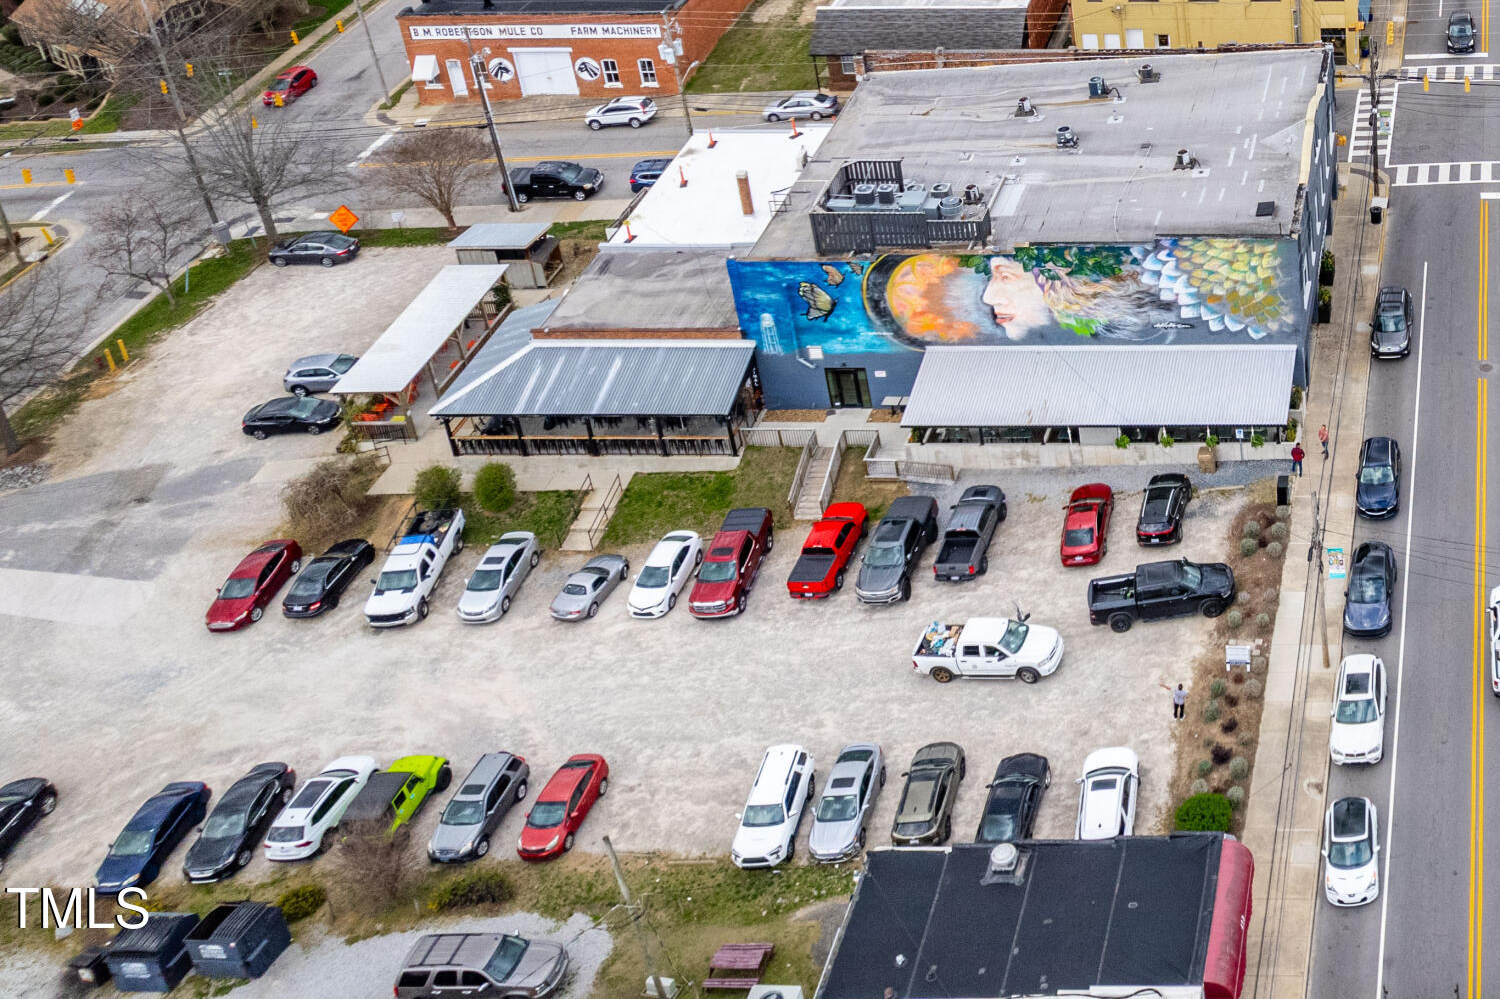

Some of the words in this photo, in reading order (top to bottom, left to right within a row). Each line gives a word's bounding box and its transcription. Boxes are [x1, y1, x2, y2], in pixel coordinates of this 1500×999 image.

[413, 29, 420, 37] B
[435, 27, 493, 37] ROBERTSON
[499, 27, 527, 37] MULE
[530, 26, 544, 37] CO
[570, 26, 598, 36] FARM
[602, 26, 658, 36] MACHINERY
